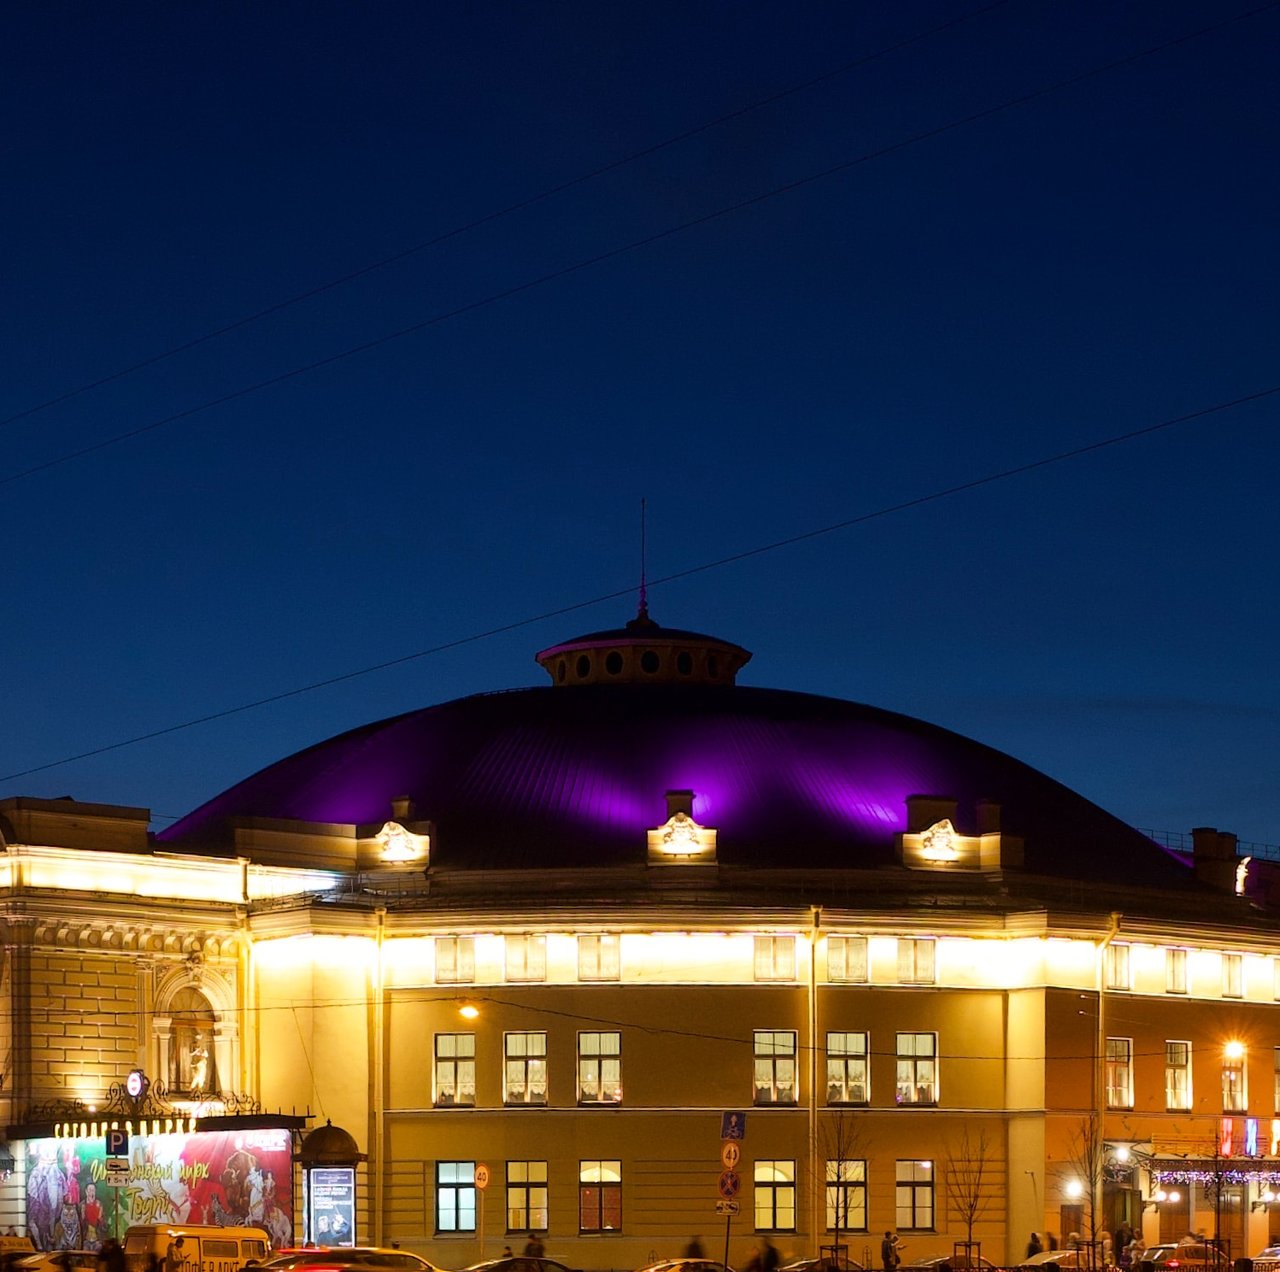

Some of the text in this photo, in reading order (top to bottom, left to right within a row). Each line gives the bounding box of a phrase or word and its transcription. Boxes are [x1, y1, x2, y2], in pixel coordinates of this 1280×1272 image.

[140, 1118, 197, 1138] ЦИРКЕ
[111, 1132, 123, 1152] P
[477, 1172, 487, 1182] 40
